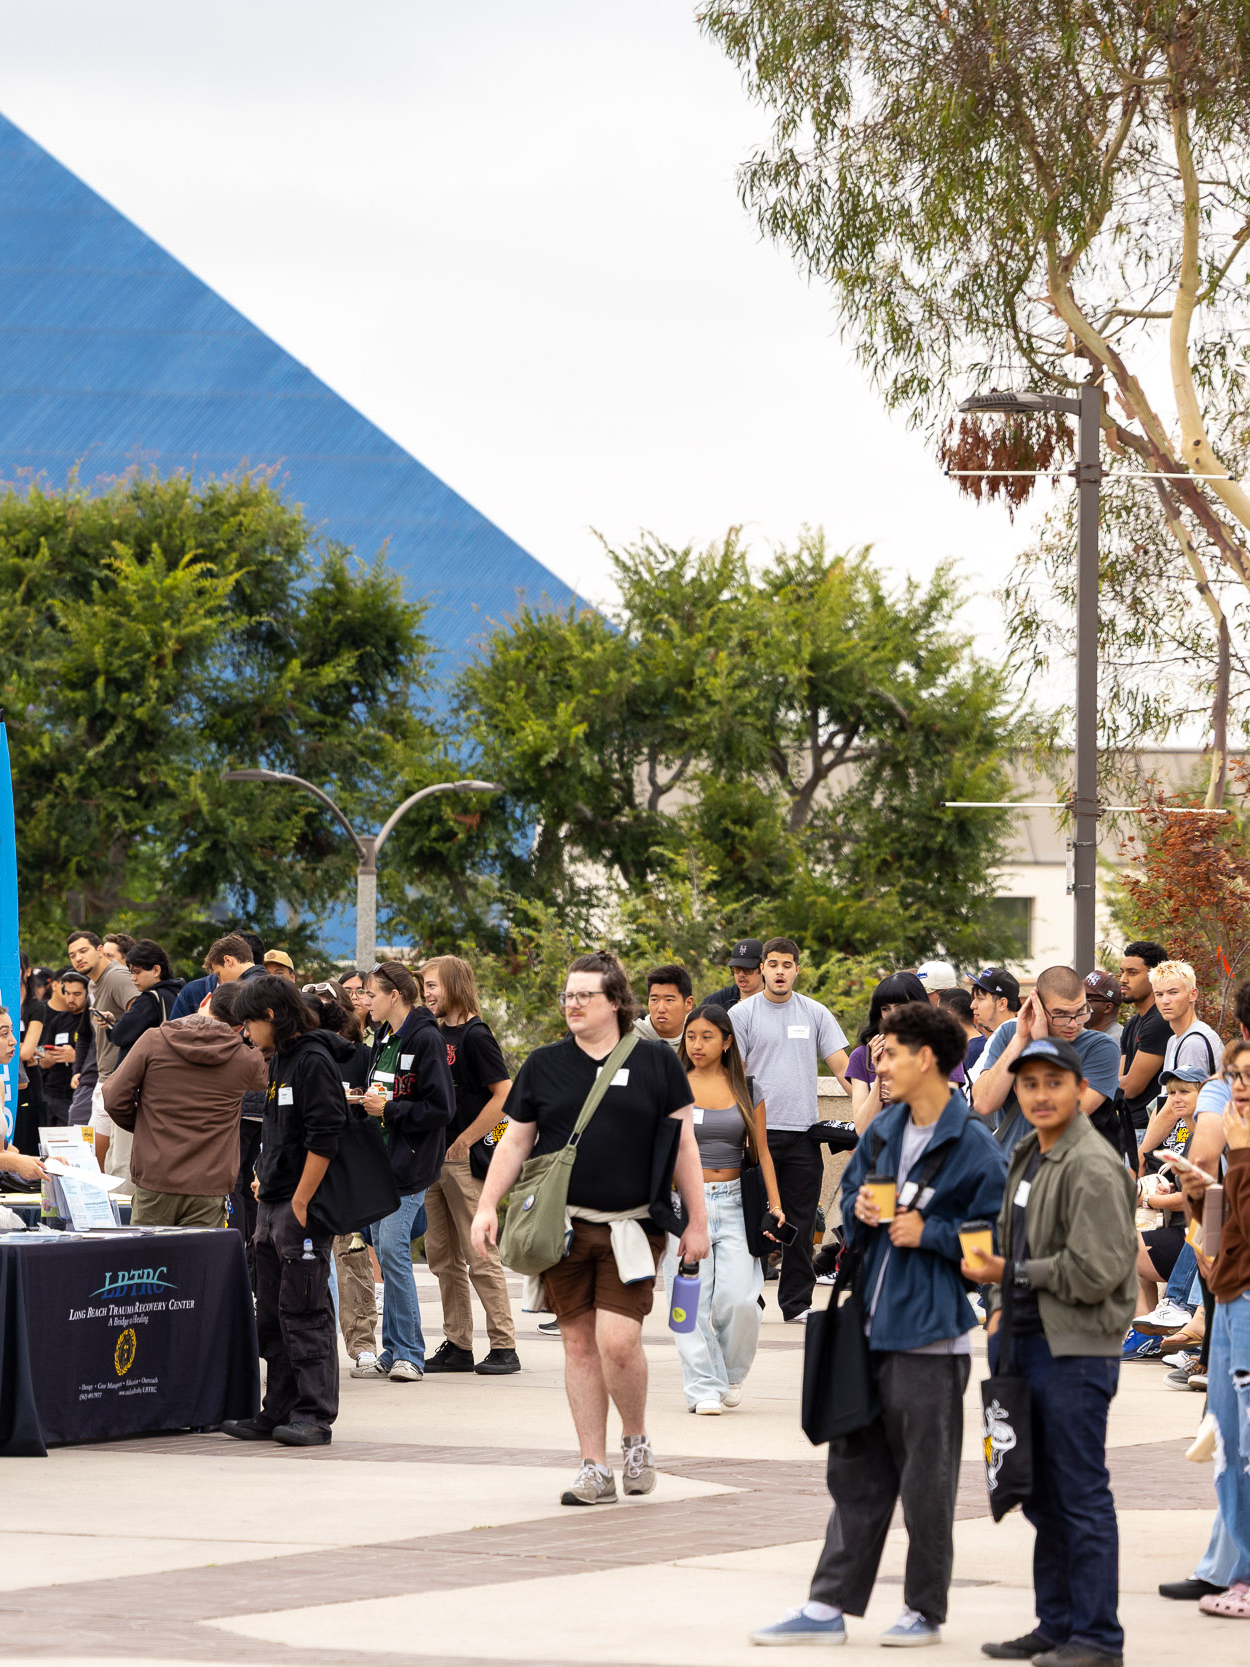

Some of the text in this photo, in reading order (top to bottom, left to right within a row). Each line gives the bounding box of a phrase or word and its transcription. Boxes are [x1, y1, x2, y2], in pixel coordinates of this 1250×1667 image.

[101, 1266, 167, 1299] LBTRC
[68, 1308, 86, 1321] LONG
[87, 1306, 107, 1317] BEACH
[135, 1301, 168, 1313] RECOVERY
[168, 1299, 195, 1310] CENTER
[108, 1318, 113, 1326] A
